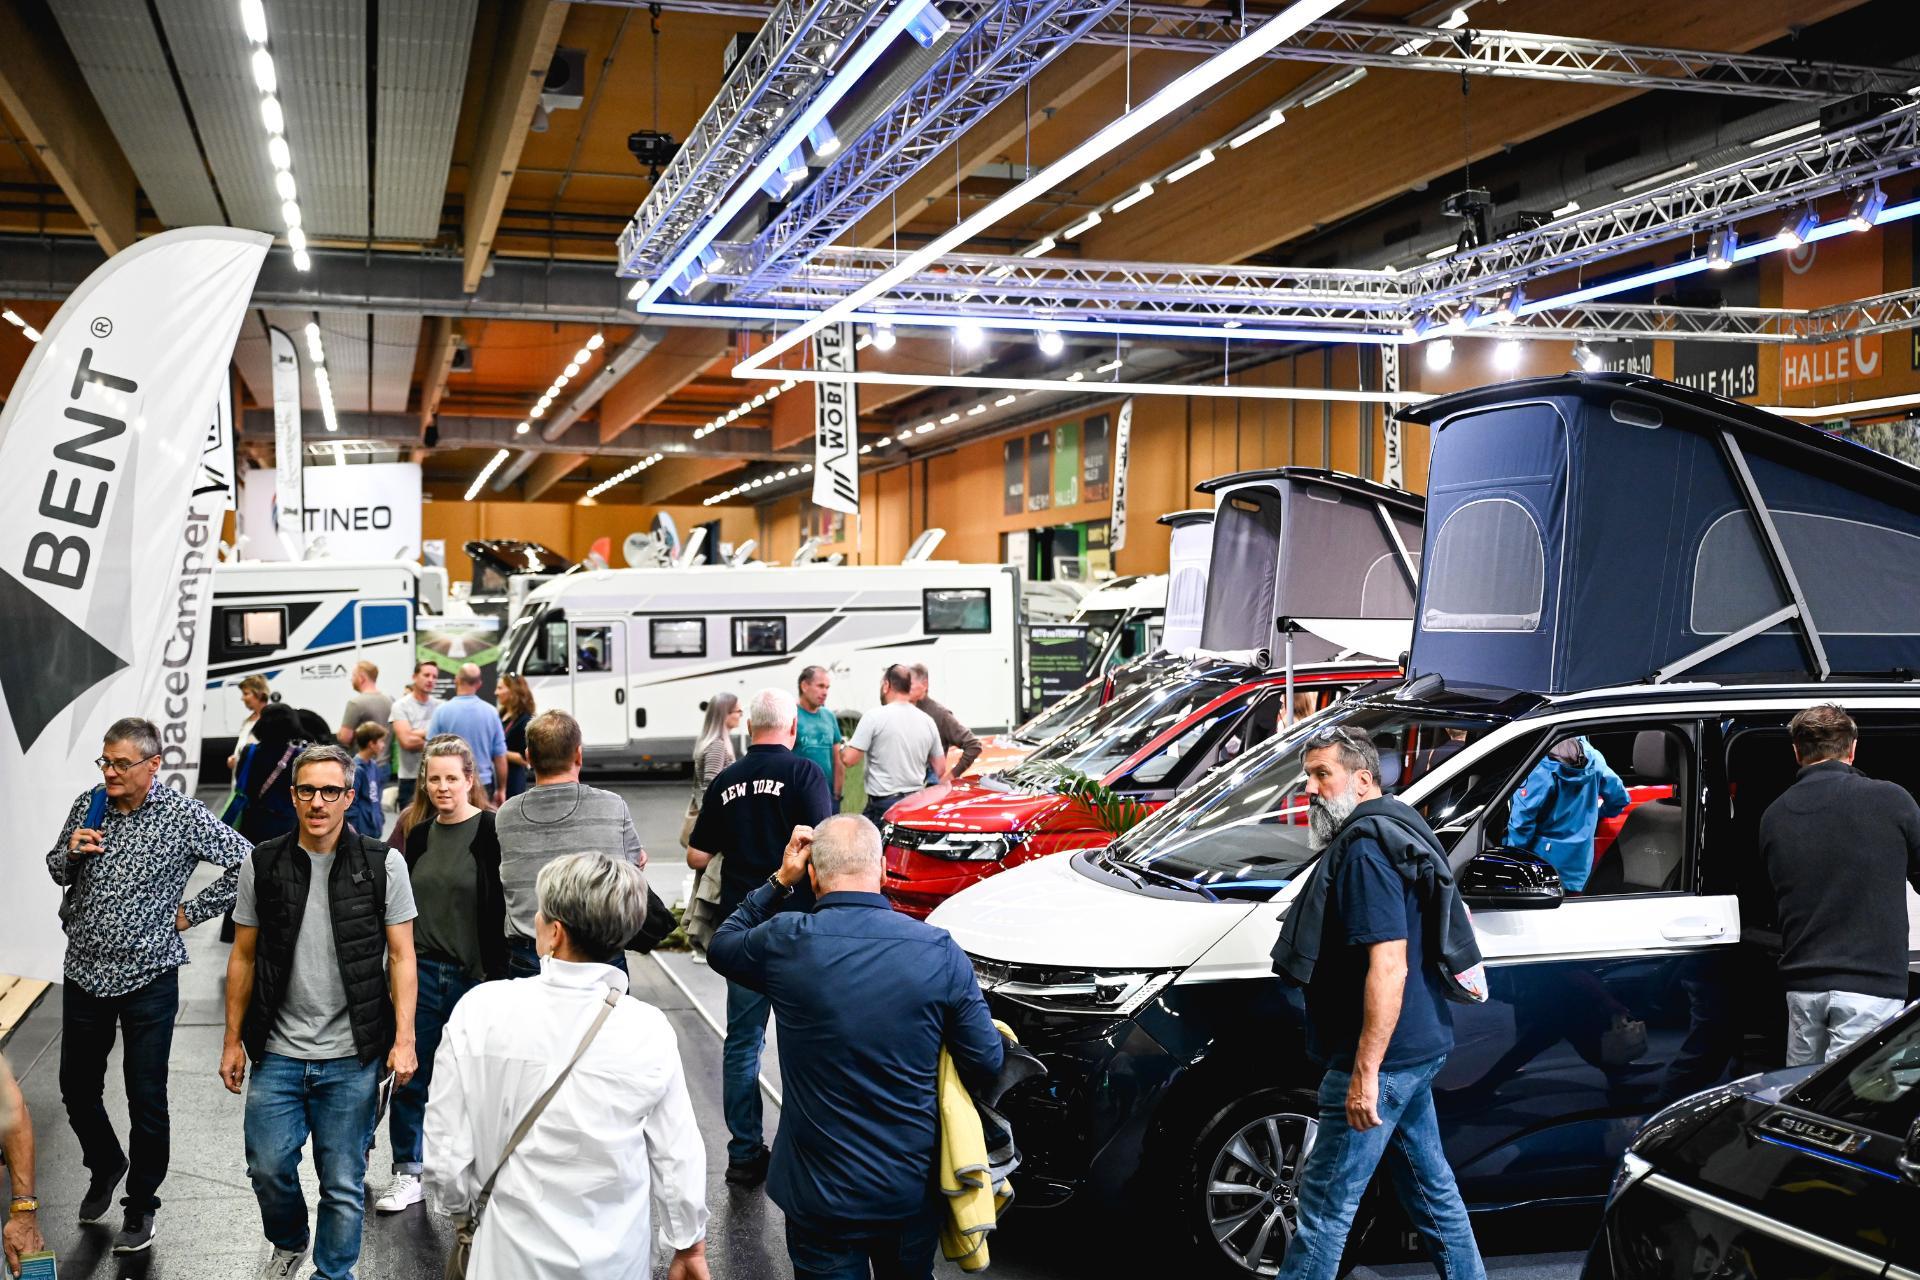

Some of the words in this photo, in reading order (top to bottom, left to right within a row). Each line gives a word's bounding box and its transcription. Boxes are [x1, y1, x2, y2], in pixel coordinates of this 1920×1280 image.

[1785, 347, 1849, 387] HALLE
[1855, 317, 1878, 375] C
[1721, 364, 1754, 397] 11-13
[721, 782, 747, 805] NEW
[753, 779, 784, 796] YORK
